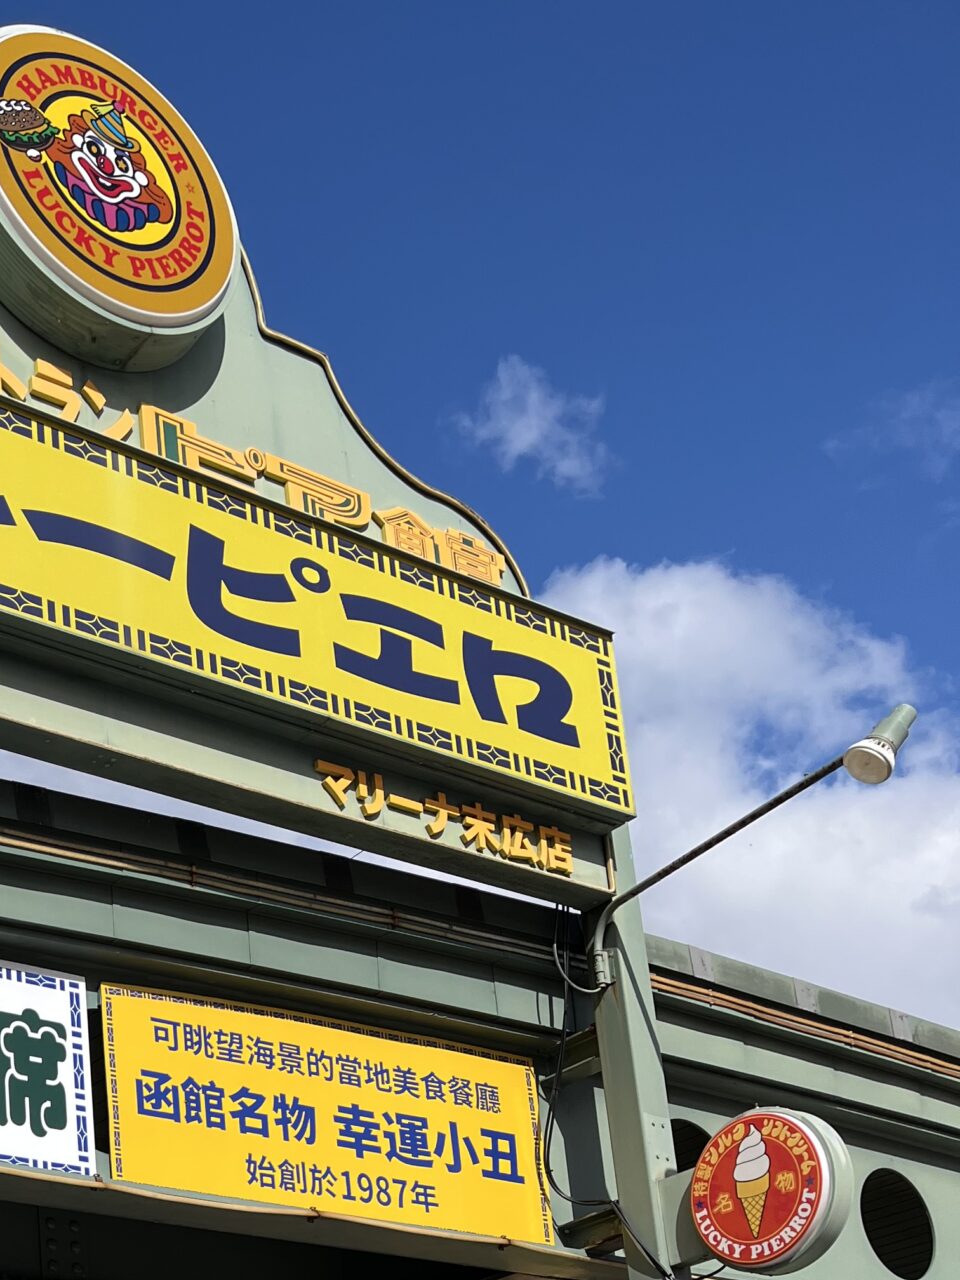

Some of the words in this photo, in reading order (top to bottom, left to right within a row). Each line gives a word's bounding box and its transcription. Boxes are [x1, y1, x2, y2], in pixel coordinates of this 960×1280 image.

[15, 63, 189, 176] HAMBURGER
[21, 167, 120, 269] LUCKY
[129, 201, 208, 281] PIERROT
[314, 758, 574, 876] マリーナ末広店
[150, 1017, 501, 1115] 可眺望海景的當地美食餐廳
[135, 1069, 317, 1145] 函館名物
[333, 1103, 526, 1185] 幸運小丑
[245, 1153, 440, 1213] 始創於1987年
[694, 1208, 745, 1259] LUCKY
[751, 1188, 817, 1260] PIERROT
